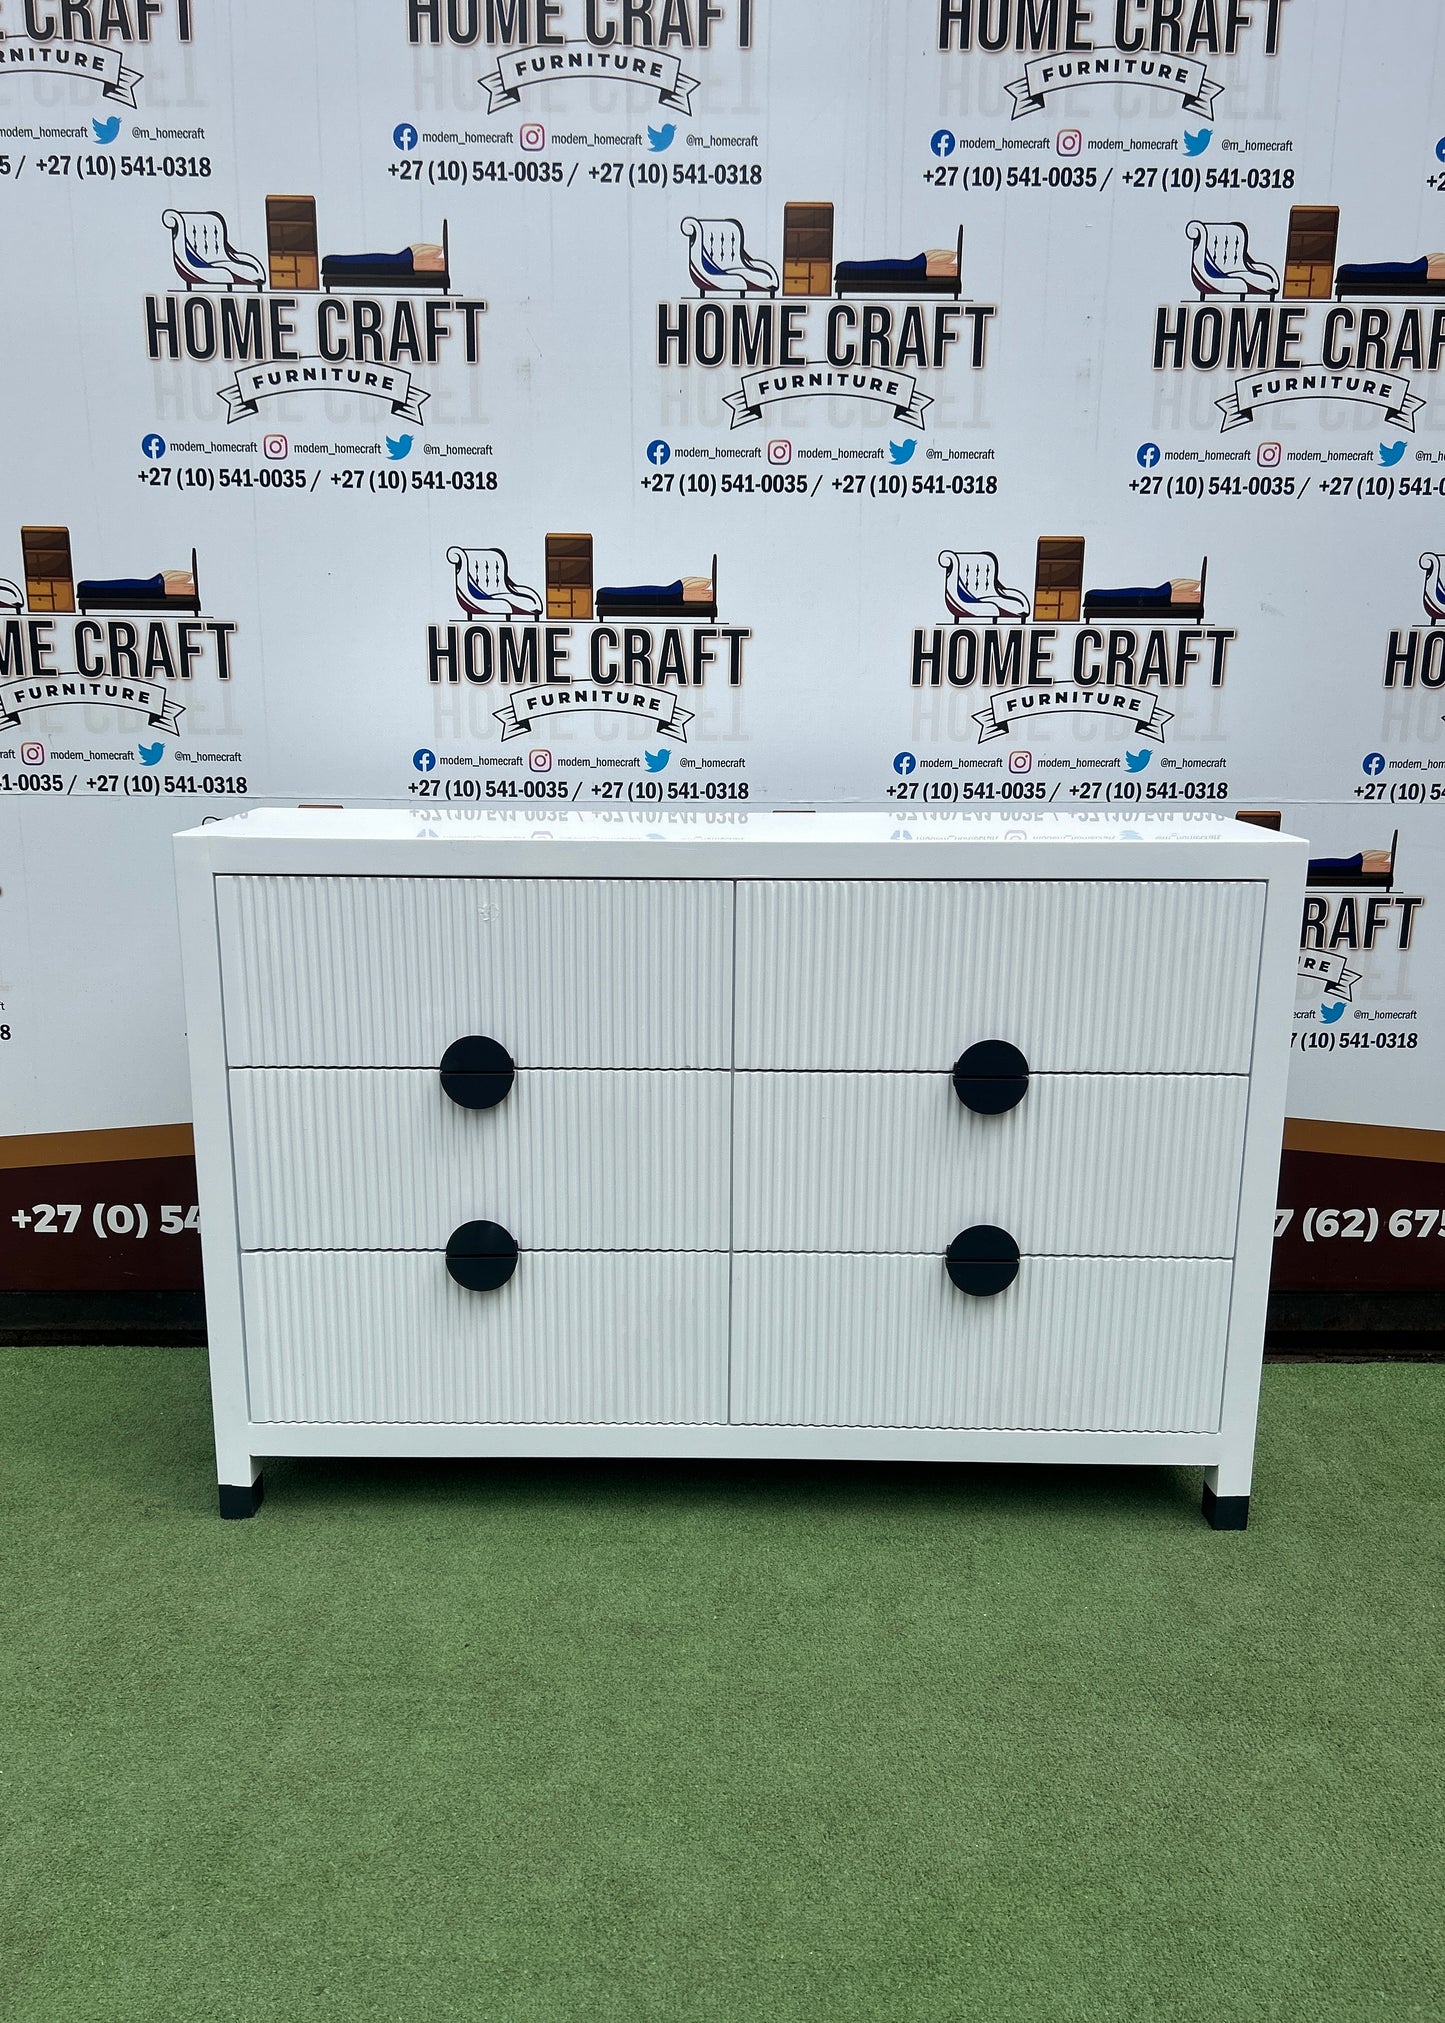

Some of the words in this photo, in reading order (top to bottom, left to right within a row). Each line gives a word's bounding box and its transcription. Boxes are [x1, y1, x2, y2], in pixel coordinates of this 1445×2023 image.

[408, 0, 564, 46] HOME
[937, 0, 1093, 51] HOME
[515, 52, 664, 78] FURNITURE
[1042, 58, 1190, 84] FURNITURE
[131, 126, 206, 141] @m_homecraft
[685, 134, 759, 149] @m_homecraft
[1221, 139, 1293, 153] @m_homecraft
[145, 295, 300, 362] HOME
[317, 298, 486, 363] CRAFT
[657, 303, 808, 367] HOME
[826, 303, 995, 369] CRAFT
[1152, 306, 1308, 371] HOME
[252, 367, 395, 391] FURNITURE
[758, 373, 900, 396] FURNITURE
[1252, 375, 1393, 399] FURNITURE
[423, 443, 493, 457] @m_homecraft
[925, 448, 995, 462] @m_homecraft
[74, 620, 237, 680] CRAFT
[427, 625, 572, 684] HOME
[590, 627, 750, 686] CRAFT
[911, 628, 1056, 686] HOME
[1072, 628, 1235, 687] CRAFT
[1384, 630, 1445, 687] HO
[14, 683, 151, 704] FURNITURE
[527, 690, 661, 712] FURNITURE
[1006, 690, 1142, 712] FURNITURE
[174, 750, 243, 764] @m_homecraft
[679, 757, 746, 770] @m_homecraft
[1160, 757, 1227, 770] @m_homecraft
[1353, 1009, 1418, 1021] @m_homecraft
[92, 1203, 149, 1239] (0)
[1302, 1207, 1379, 1243] (62)
